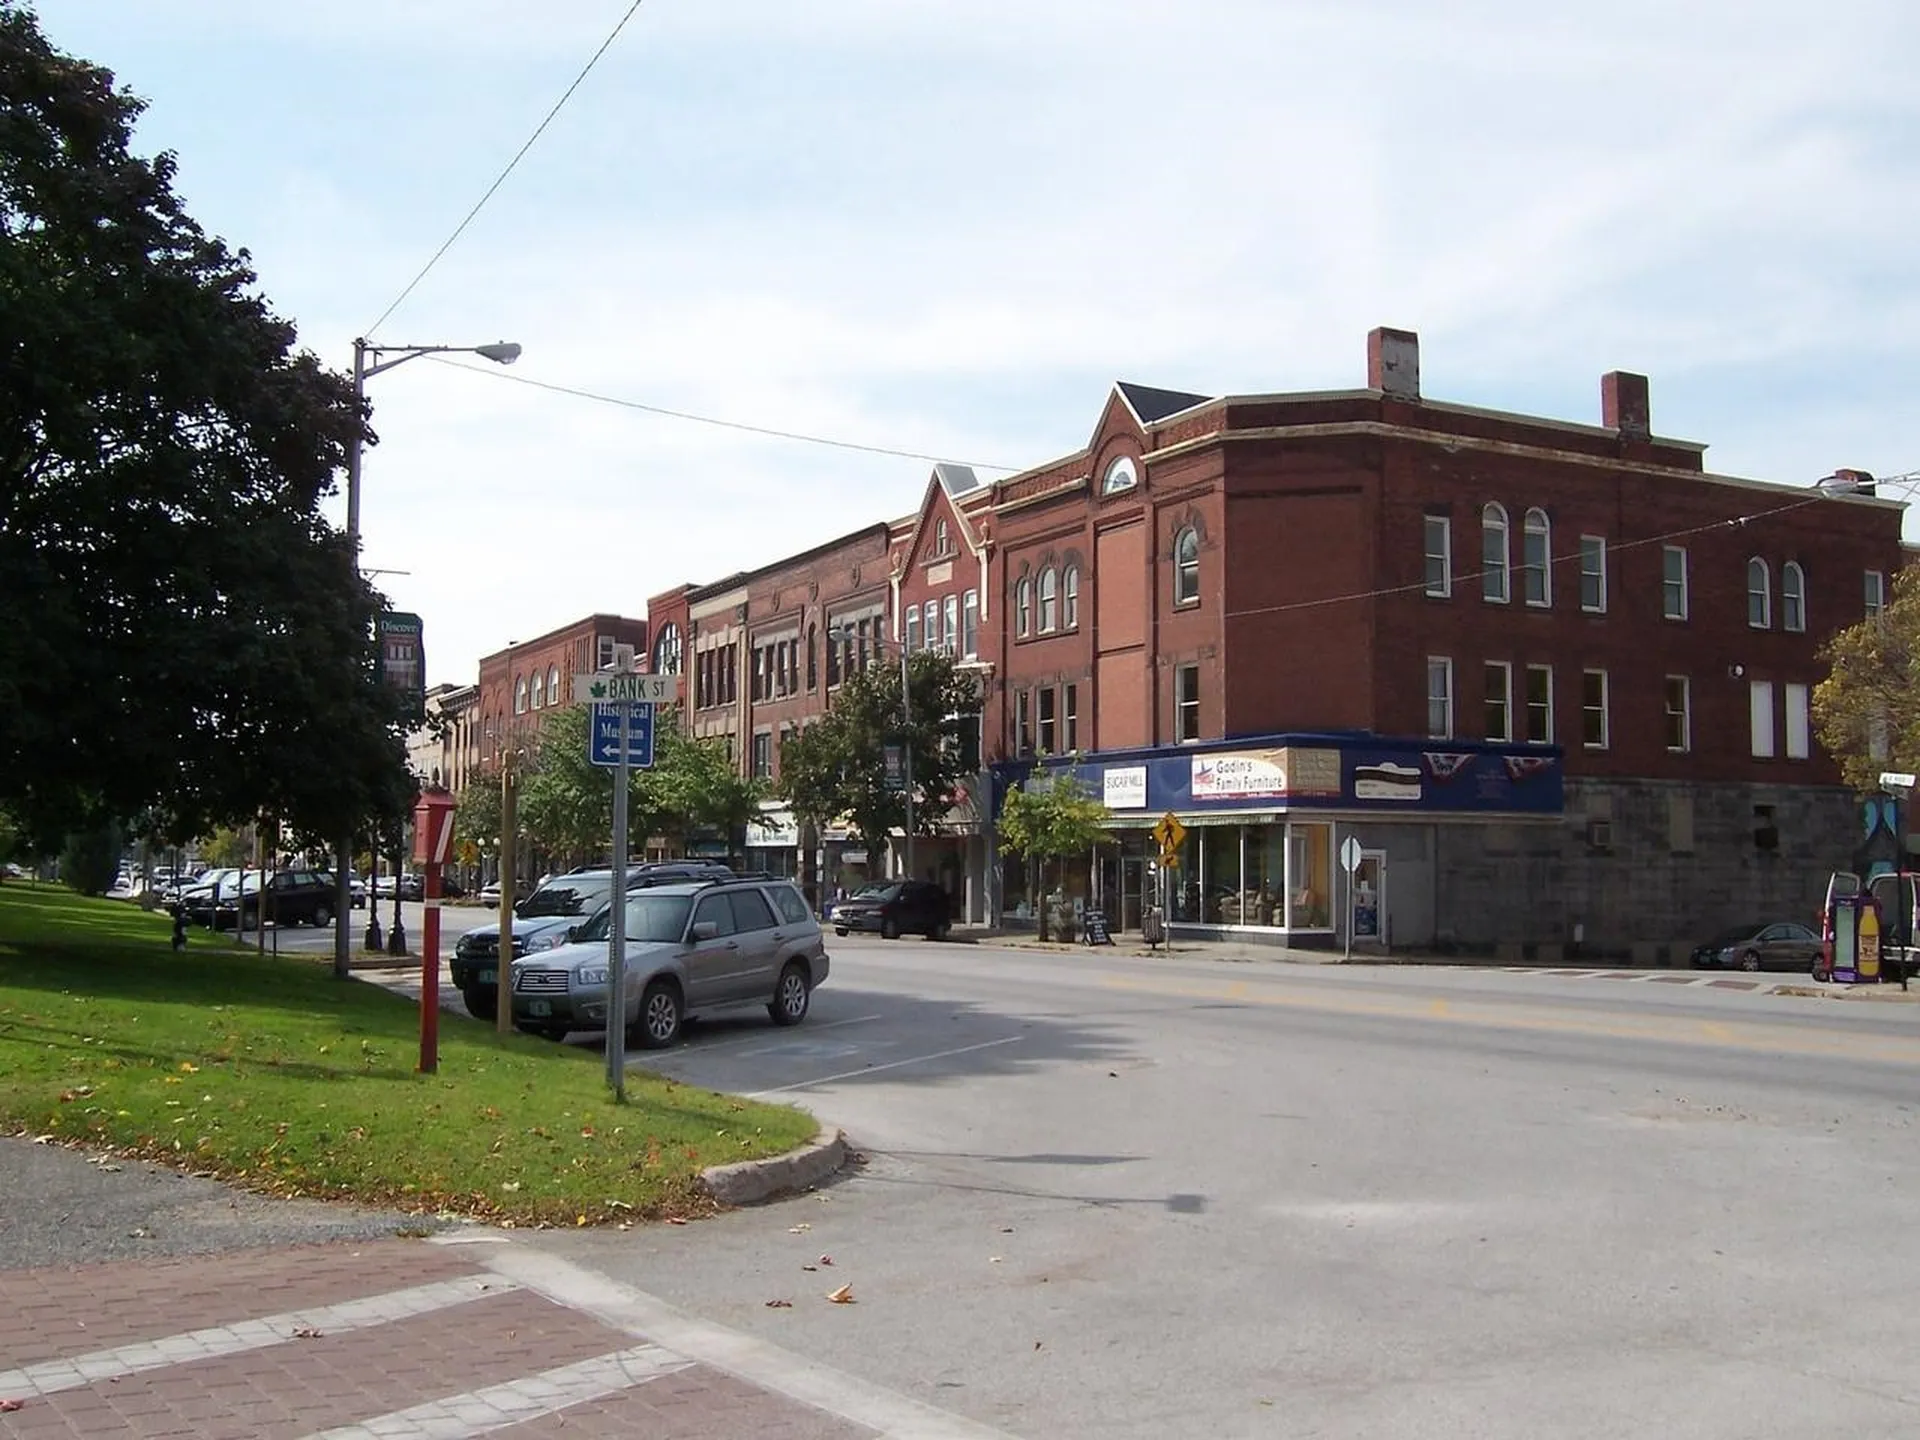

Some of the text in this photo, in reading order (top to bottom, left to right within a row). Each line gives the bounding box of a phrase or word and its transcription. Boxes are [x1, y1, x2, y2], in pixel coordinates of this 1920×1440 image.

[609, 678, 665, 699] BANK ST
[598, 702, 649, 719] Histical
[601, 722, 644, 740] Musum
[1216, 774, 1283, 790] Family Furniture
